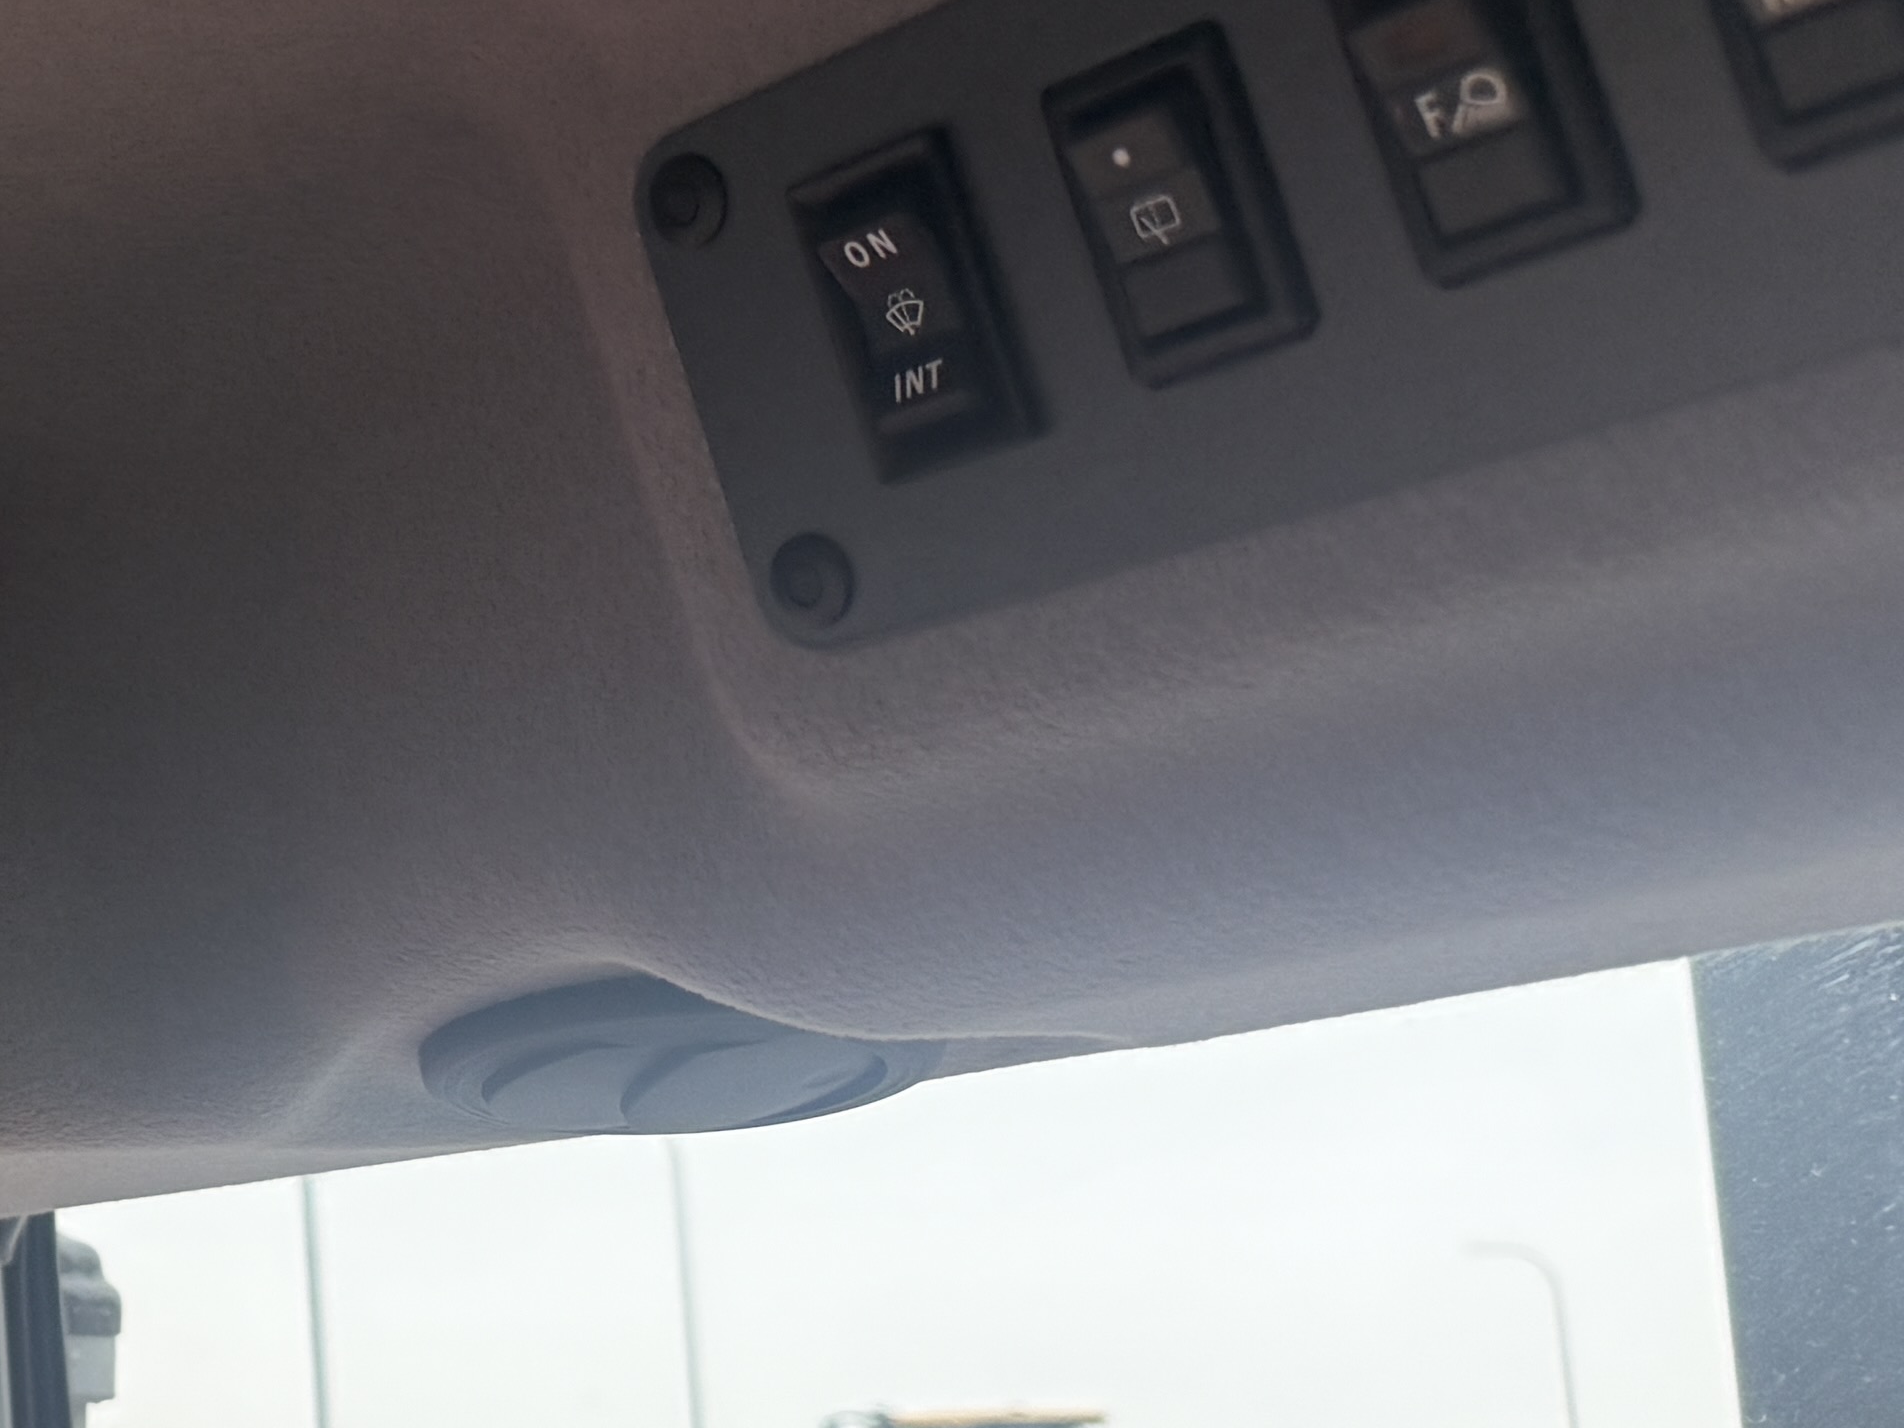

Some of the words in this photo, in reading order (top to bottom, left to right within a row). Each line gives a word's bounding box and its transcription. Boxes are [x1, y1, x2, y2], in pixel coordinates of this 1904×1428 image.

[1414, 89, 1448, 140] F
[843, 227, 899, 269] ON
[894, 357, 944, 404] INT
